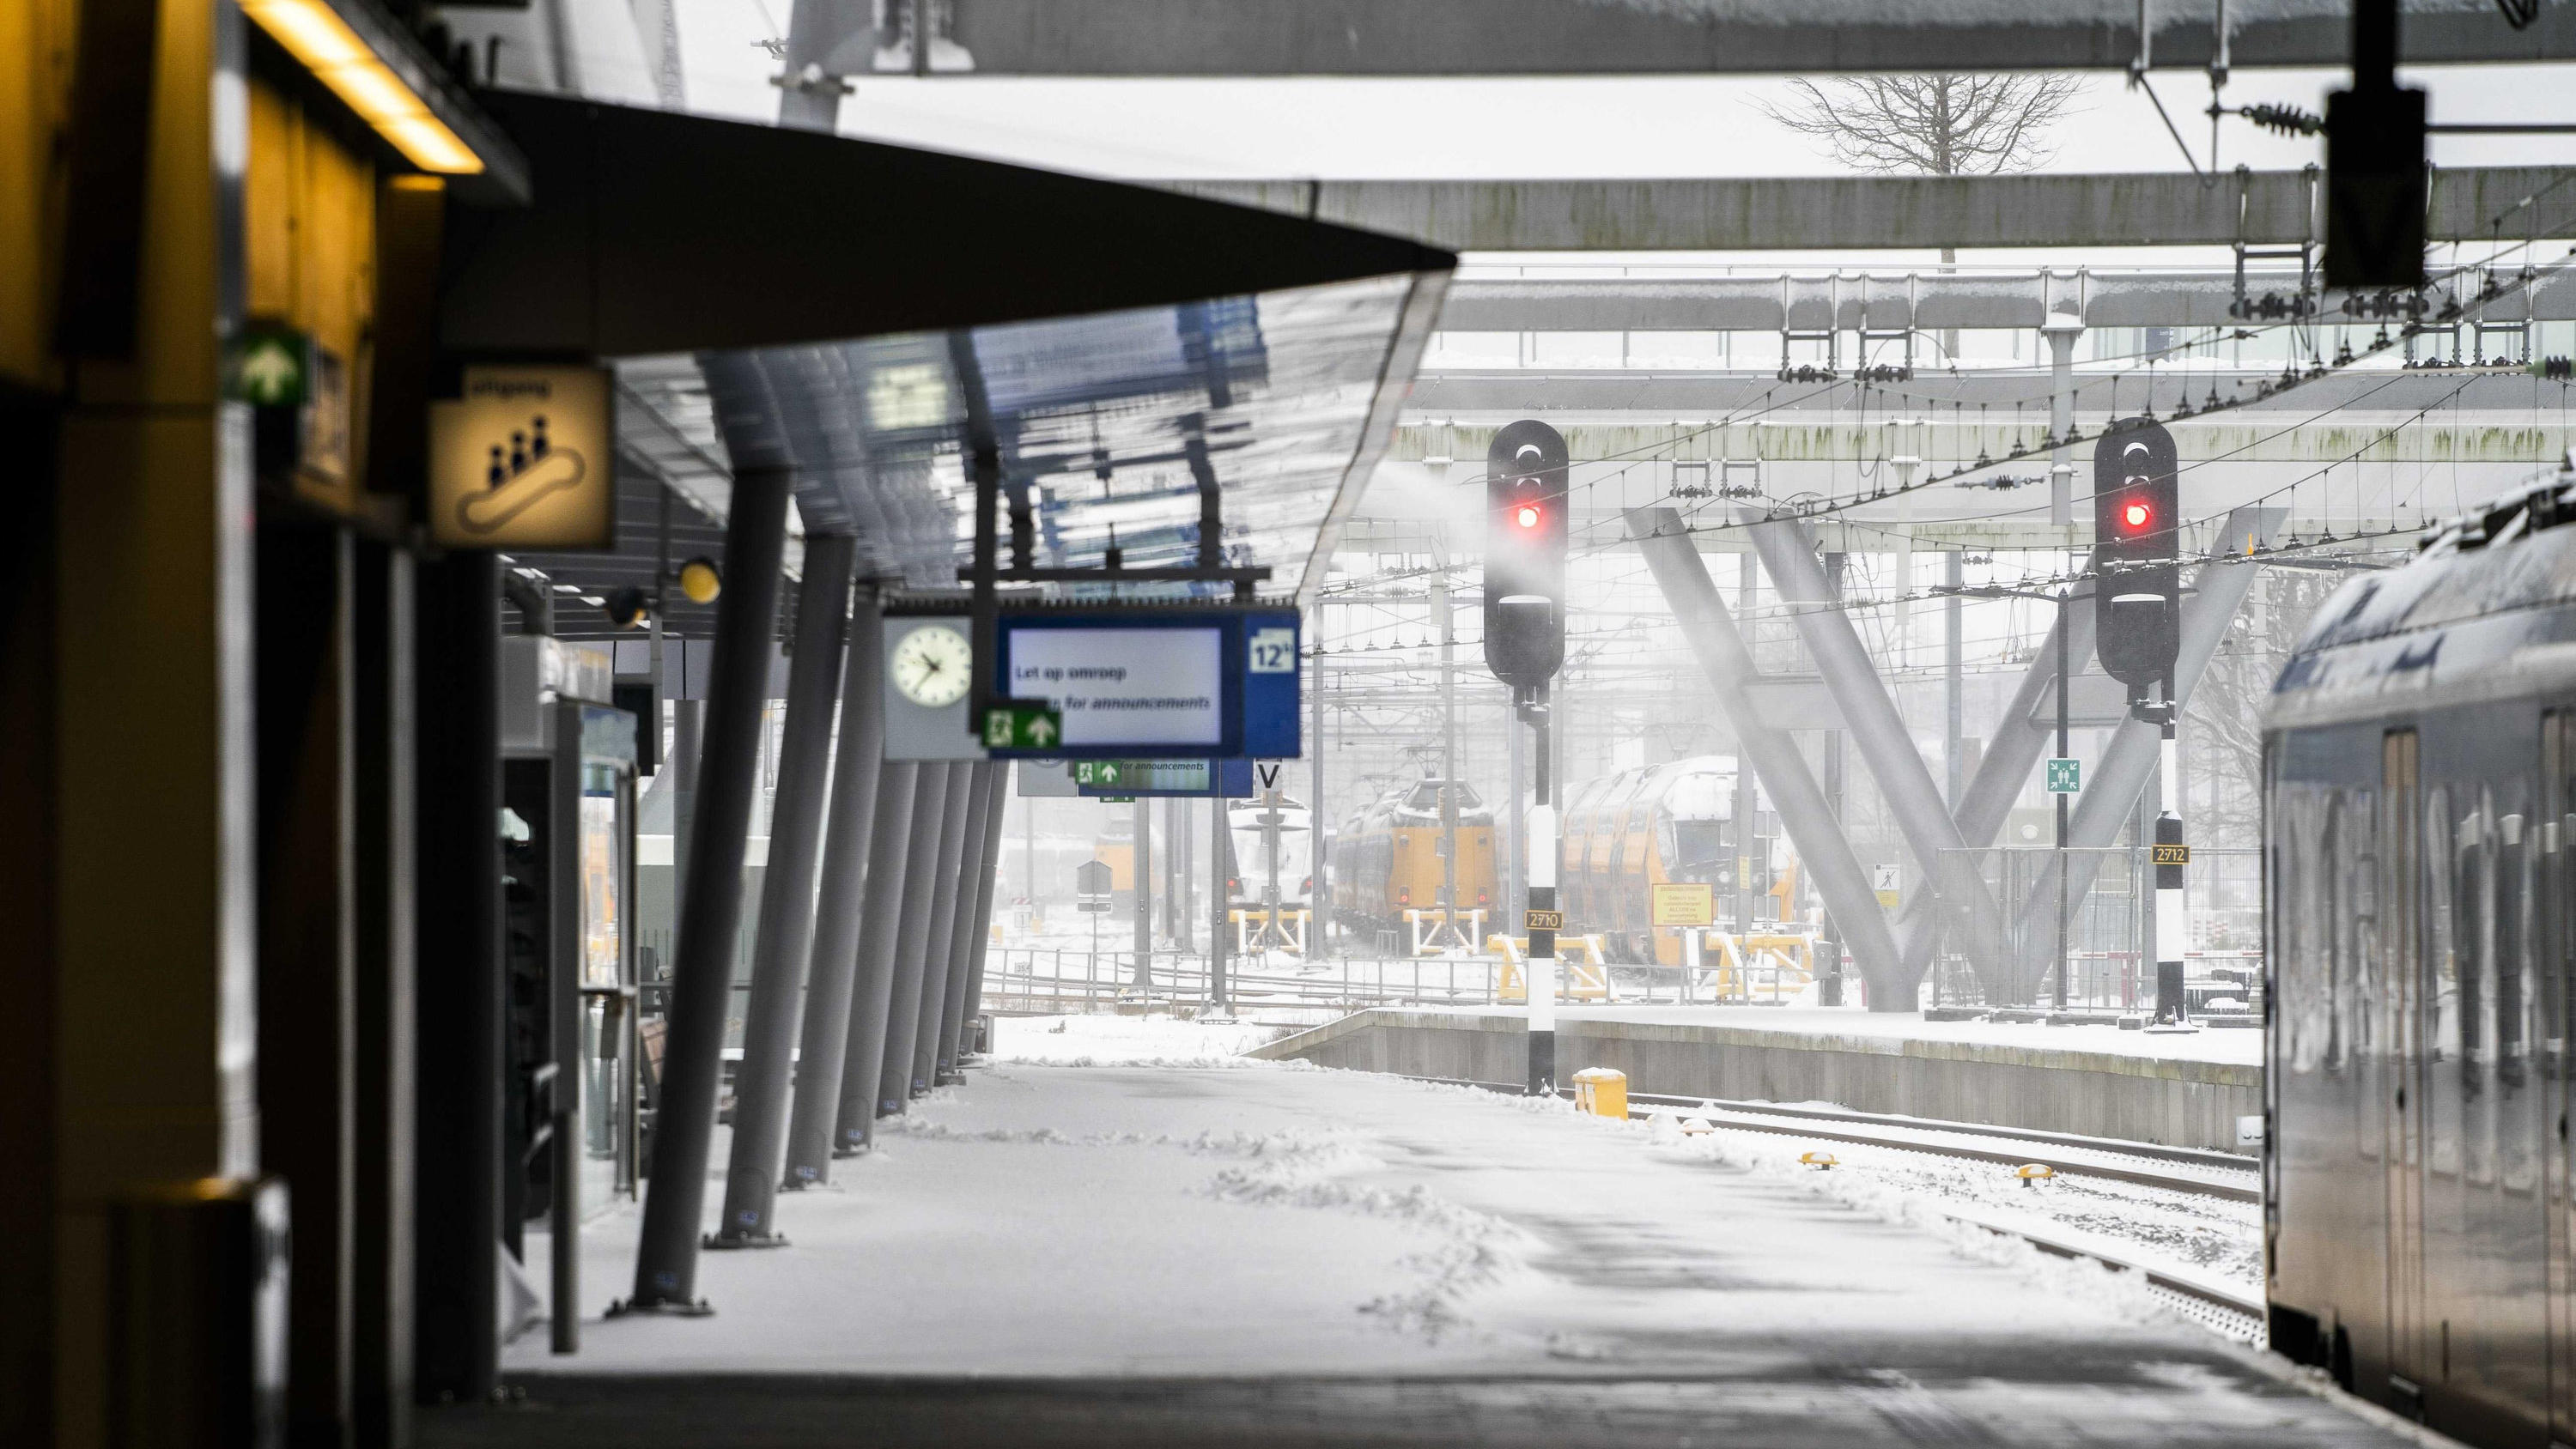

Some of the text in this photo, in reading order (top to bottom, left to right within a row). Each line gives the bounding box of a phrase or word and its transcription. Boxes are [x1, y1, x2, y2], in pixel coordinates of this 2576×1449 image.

[1016, 666, 1127, 682] Let op omroep
[1066, 695, 1088, 710] for
[1091, 696, 1211, 710] announcements
[1120, 761, 1205, 771] for announcements
[1257, 764, 1279, 788] V
[2157, 848, 2185, 861] 2712
[1530, 913, 1558, 927] 2710
